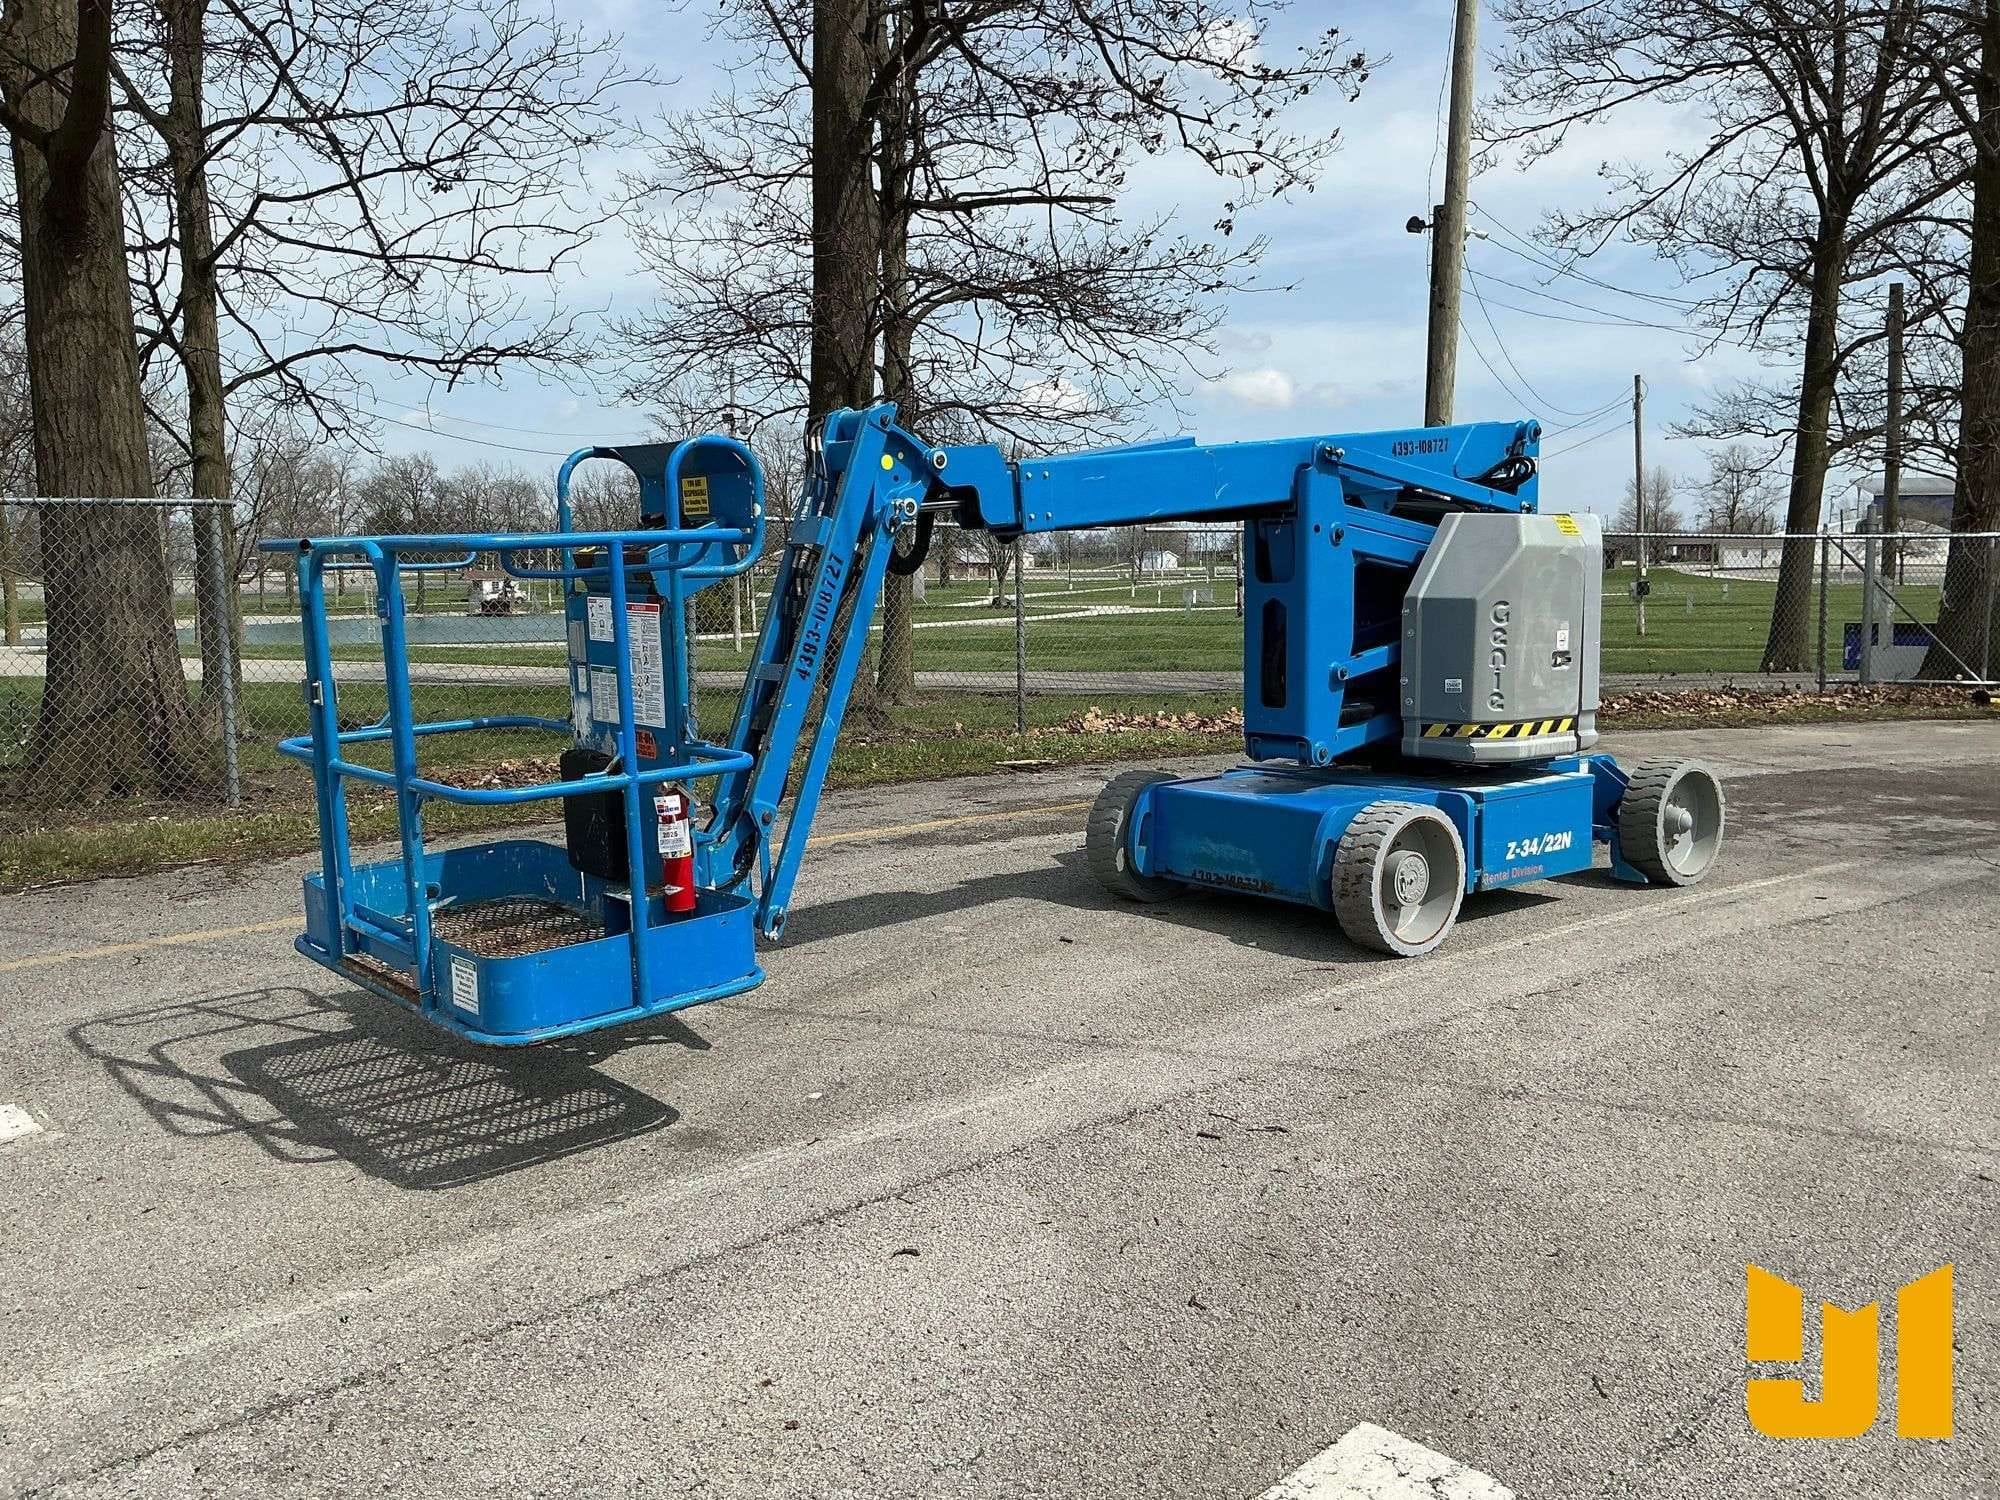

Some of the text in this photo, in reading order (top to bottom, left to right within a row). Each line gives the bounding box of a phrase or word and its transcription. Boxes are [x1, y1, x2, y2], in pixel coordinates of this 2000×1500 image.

[1392, 438, 1449, 457] 4393-108727
[796, 553, 844, 681] 4393-108727
[1486, 600, 1511, 712] Genie
[1505, 831, 1572, 861] Z-34/22N
[1511, 864, 1544, 878] Division
